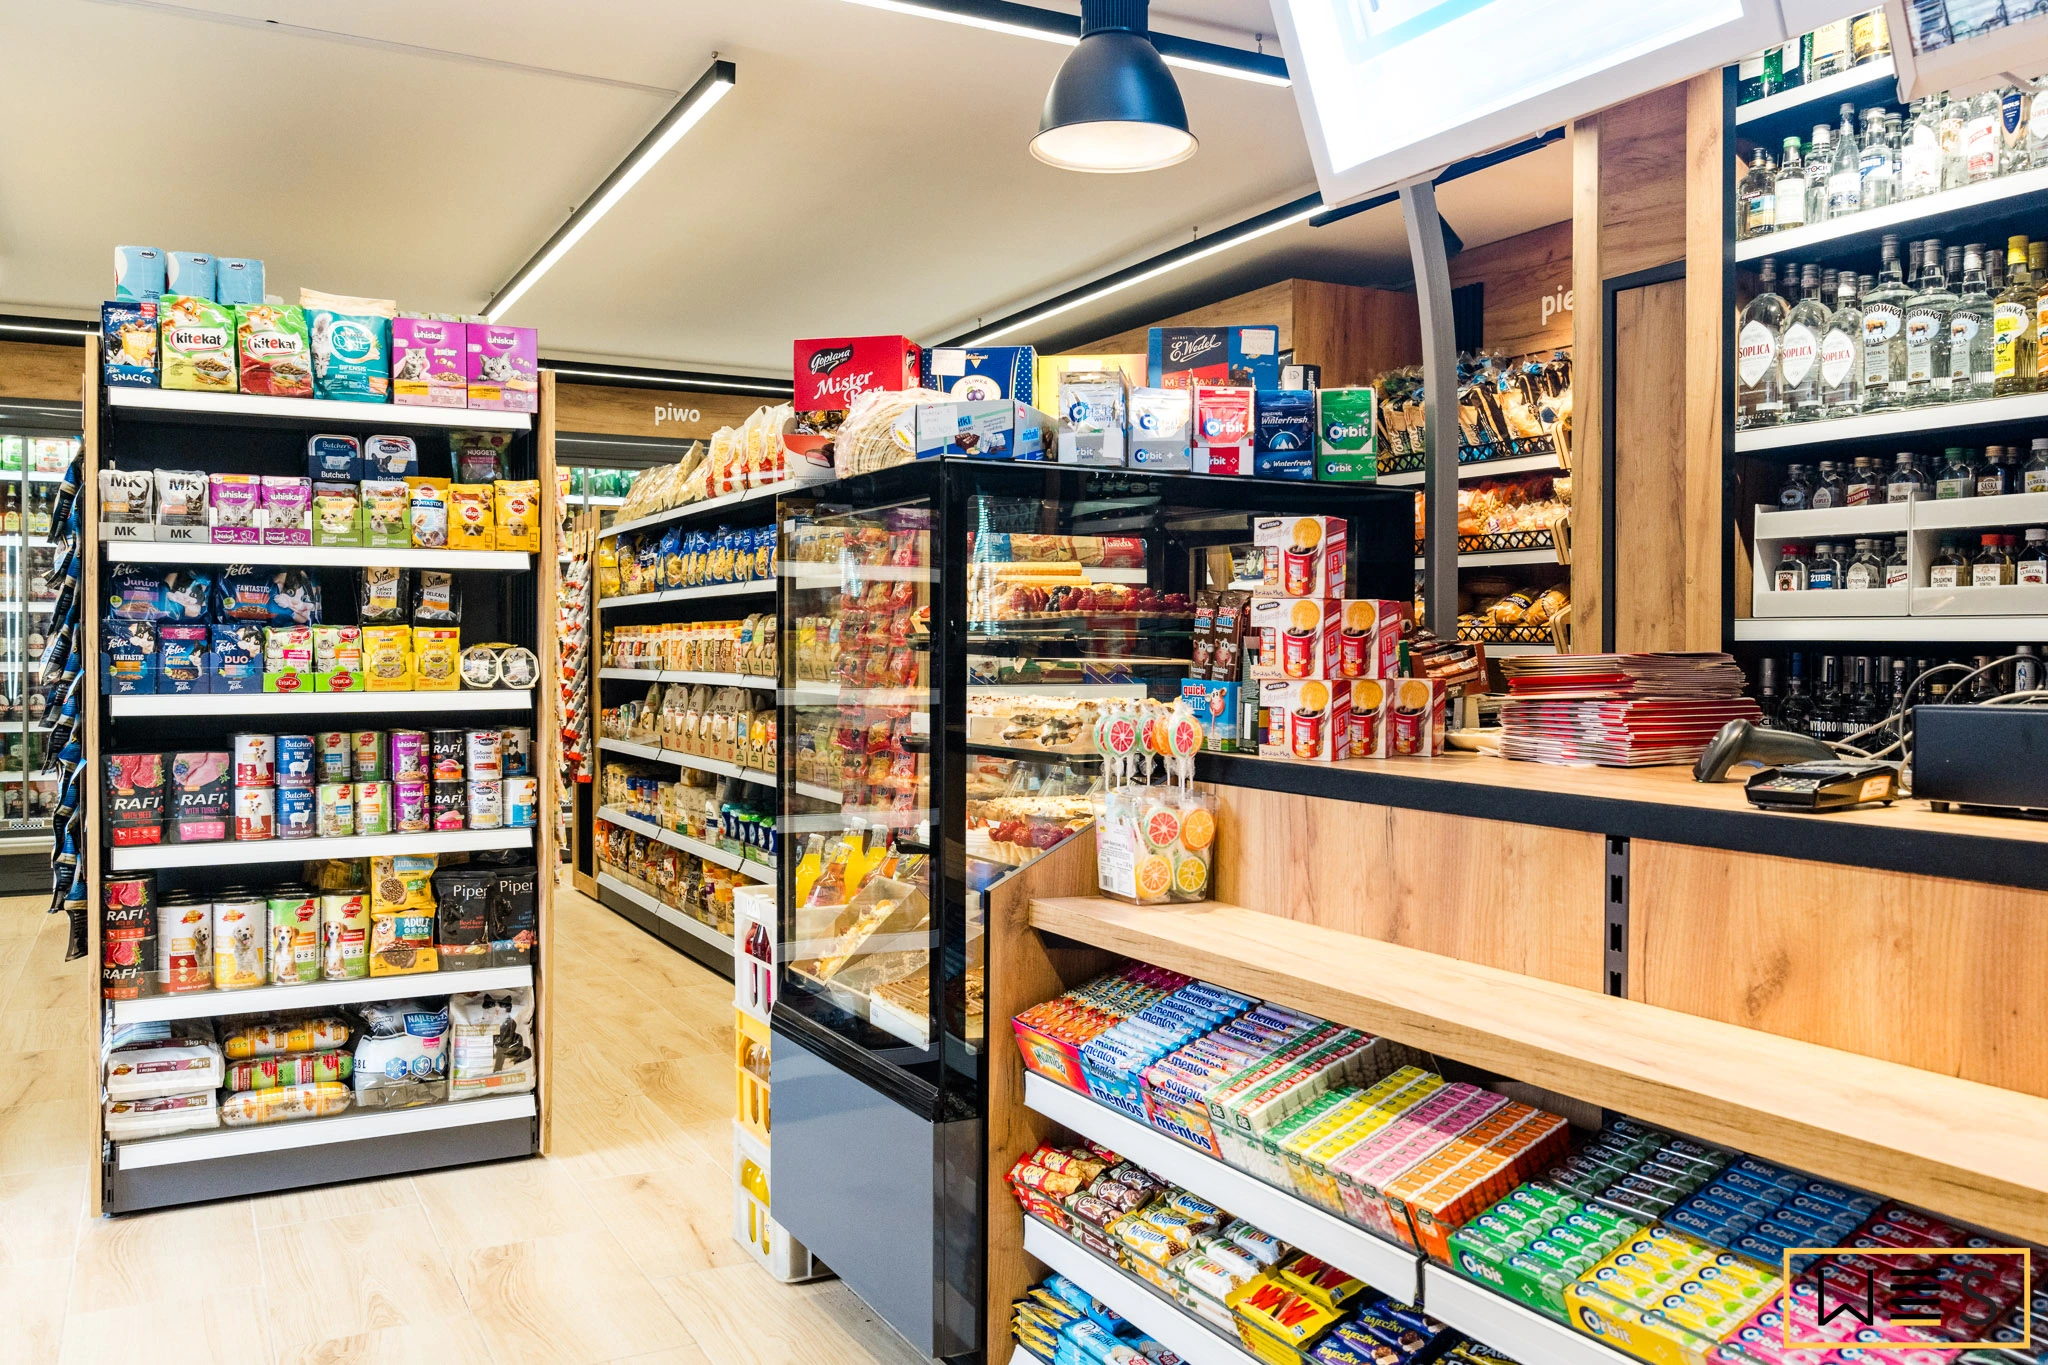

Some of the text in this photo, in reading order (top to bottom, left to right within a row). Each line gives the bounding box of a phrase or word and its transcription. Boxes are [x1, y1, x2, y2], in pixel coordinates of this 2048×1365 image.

[2002, 100, 2020, 109] BOLS
[176, 332, 222, 346] kitekat
[253, 335, 298, 350] kitekat
[413, 330, 445, 340] whiskas
[487, 335, 518, 346] whiskas
[1739, 343, 1770, 358] SOPLICA
[1782, 345, 1812, 360] SOPLICA
[1822, 349, 1850, 362] SOPLICA
[811, 348, 851, 375] Goplana
[112, 373, 152, 384] SNACKS
[813, 371, 874, 400] Mister
[654, 402, 701, 426] piwo
[1261, 416, 1309, 425] Winterfresh
[1203, 416, 1245, 437] Orbit
[1326, 421, 1368, 443] Orbit
[467, 449, 497, 457] NUGGETS
[1134, 448, 1163, 464] Orbit
[1209, 456, 1227, 465] rbit
[1273, 459, 1312, 468] Winterfresh
[1325, 461, 1352, 476] Orbit
[110, 473, 142, 489] MK
[320, 470, 351, 480] Butcher's
[168, 478, 200, 491] MK
[1980, 481, 1997, 491] SASKA
[219, 490, 253, 500] whiskas
[270, 492, 304, 502] whiskas
[114, 526, 137, 537] MK
[170, 529, 193, 539] MK
[223, 562, 254, 579] felix
[1810, 572, 1832, 582] ŻUBR
[123, 576, 160, 588] Junior
[236, 584, 271, 593] FANTASTIC
[1273, 588, 1284, 597] Mug
[1216, 615, 1234, 627] milk
[107, 637, 130, 650] felix
[165, 643, 187, 655] felix
[215, 642, 238, 654] felix
[113, 653, 145, 661] FANTASTIC
[224, 655, 249, 664] DUO
[1270, 670, 1282, 679] Mug
[1183, 684, 1206, 697] quick
[284, 740, 313, 749] Butcher's
[396, 741, 420, 749] whiskas
[433, 744, 461, 754] RAFI
[1280, 750, 1291, 759] Mug
[114, 796, 160, 811] RAFI
[180, 793, 224, 806] RAFI
[284, 791, 313, 800] Butcher's
[434, 795, 462, 805] RAFI
[453, 884, 488, 900] Piper
[499, 880, 534, 895] Piper
[106, 909, 145, 921] RAFI
[403, 917, 430, 928] ADULT
[103, 967, 137, 980] RAFI
[1178, 990, 1214, 1008] mentos
[1190, 984, 1222, 999] mentos
[1154, 1006, 1185, 1022] mentos
[1166, 999, 1195, 1015] mentos
[407, 1010, 448, 1023] NAJLEPSZY
[1141, 1011, 1177, 1030] mentos
[1247, 1012, 1289, 1031] mentos
[1225, 1025, 1264, 1044] mentos
[1083, 1044, 1118, 1065] mentos
[1171, 1055, 1210, 1077] mentos
[1094, 1086, 1144, 1119] mentos
[1155, 1114, 1212, 1151] mentos
[1614, 1120, 1644, 1136] Orbit
[1599, 1132, 1628, 1148] Orbit
[1671, 1139, 1704, 1154] Orbit
[1583, 1145, 1613, 1160] Orbit
[1656, 1151, 1689, 1167] Orbit
[1566, 1155, 1596, 1171] Orbit
[1640, 1163, 1673, 1179] Orbit
[1738, 1158, 1775, 1178] Orbit
[1549, 1166, 1578, 1182] Orbit
[1724, 1172, 1761, 1190] Orbit
[1527, 1181, 1560, 1197] Orbit
[1621, 1175, 1656, 1191] Orbit
[1510, 1190, 1544, 1209] Orbit
[1605, 1187, 1639, 1204] Orbit
[1706, 1185, 1743, 1204] Orbit
[1807, 1182, 1846, 1201] Orbit
[1178, 1195, 1217, 1216] Nesquik
[1493, 1202, 1527, 1221] Orbit
[1582, 1202, 1619, 1221] Orbit
[1689, 1199, 1727, 1217] Orbit
[1792, 1195, 1832, 1215] Orbit
[1151, 1212, 1188, 1228] Nesquik
[1476, 1214, 1510, 1234] Orbit
[1565, 1213, 1602, 1233] Orbit
[1673, 1211, 1709, 1230] Orbit
[1774, 1209, 1814, 1228] Orbit
[1887, 1209, 1929, 1229] Orbit
[1129, 1224, 1167, 1243] Nesquik
[1548, 1226, 1584, 1246] Orbit
[1757, 1222, 1797, 1242] Orbit
[1871, 1222, 1914, 1243] Orbit
[1529, 1239, 1566, 1259] Orbit
[1631, 1241, 1671, 1260] Orbit
[1739, 1236, 1779, 1256] Orbit
[1459, 1249, 1505, 1286] Orbit
[1615, 1253, 1653, 1273] Orbit
[1596, 1267, 1634, 1288] Orbit
[1698, 1266, 1739, 1287] Orbit
[1680, 1281, 1721, 1302] Orbit
[1662, 1294, 1704, 1316] Orbit
[1363, 1315, 1406, 1334] BAJECZNY
[1579, 1305, 1633, 1345] Orbit
[1339, 1327, 1380, 1347] BAJECZNY
[1320, 1346, 1360, 1365] BAJECZNY
